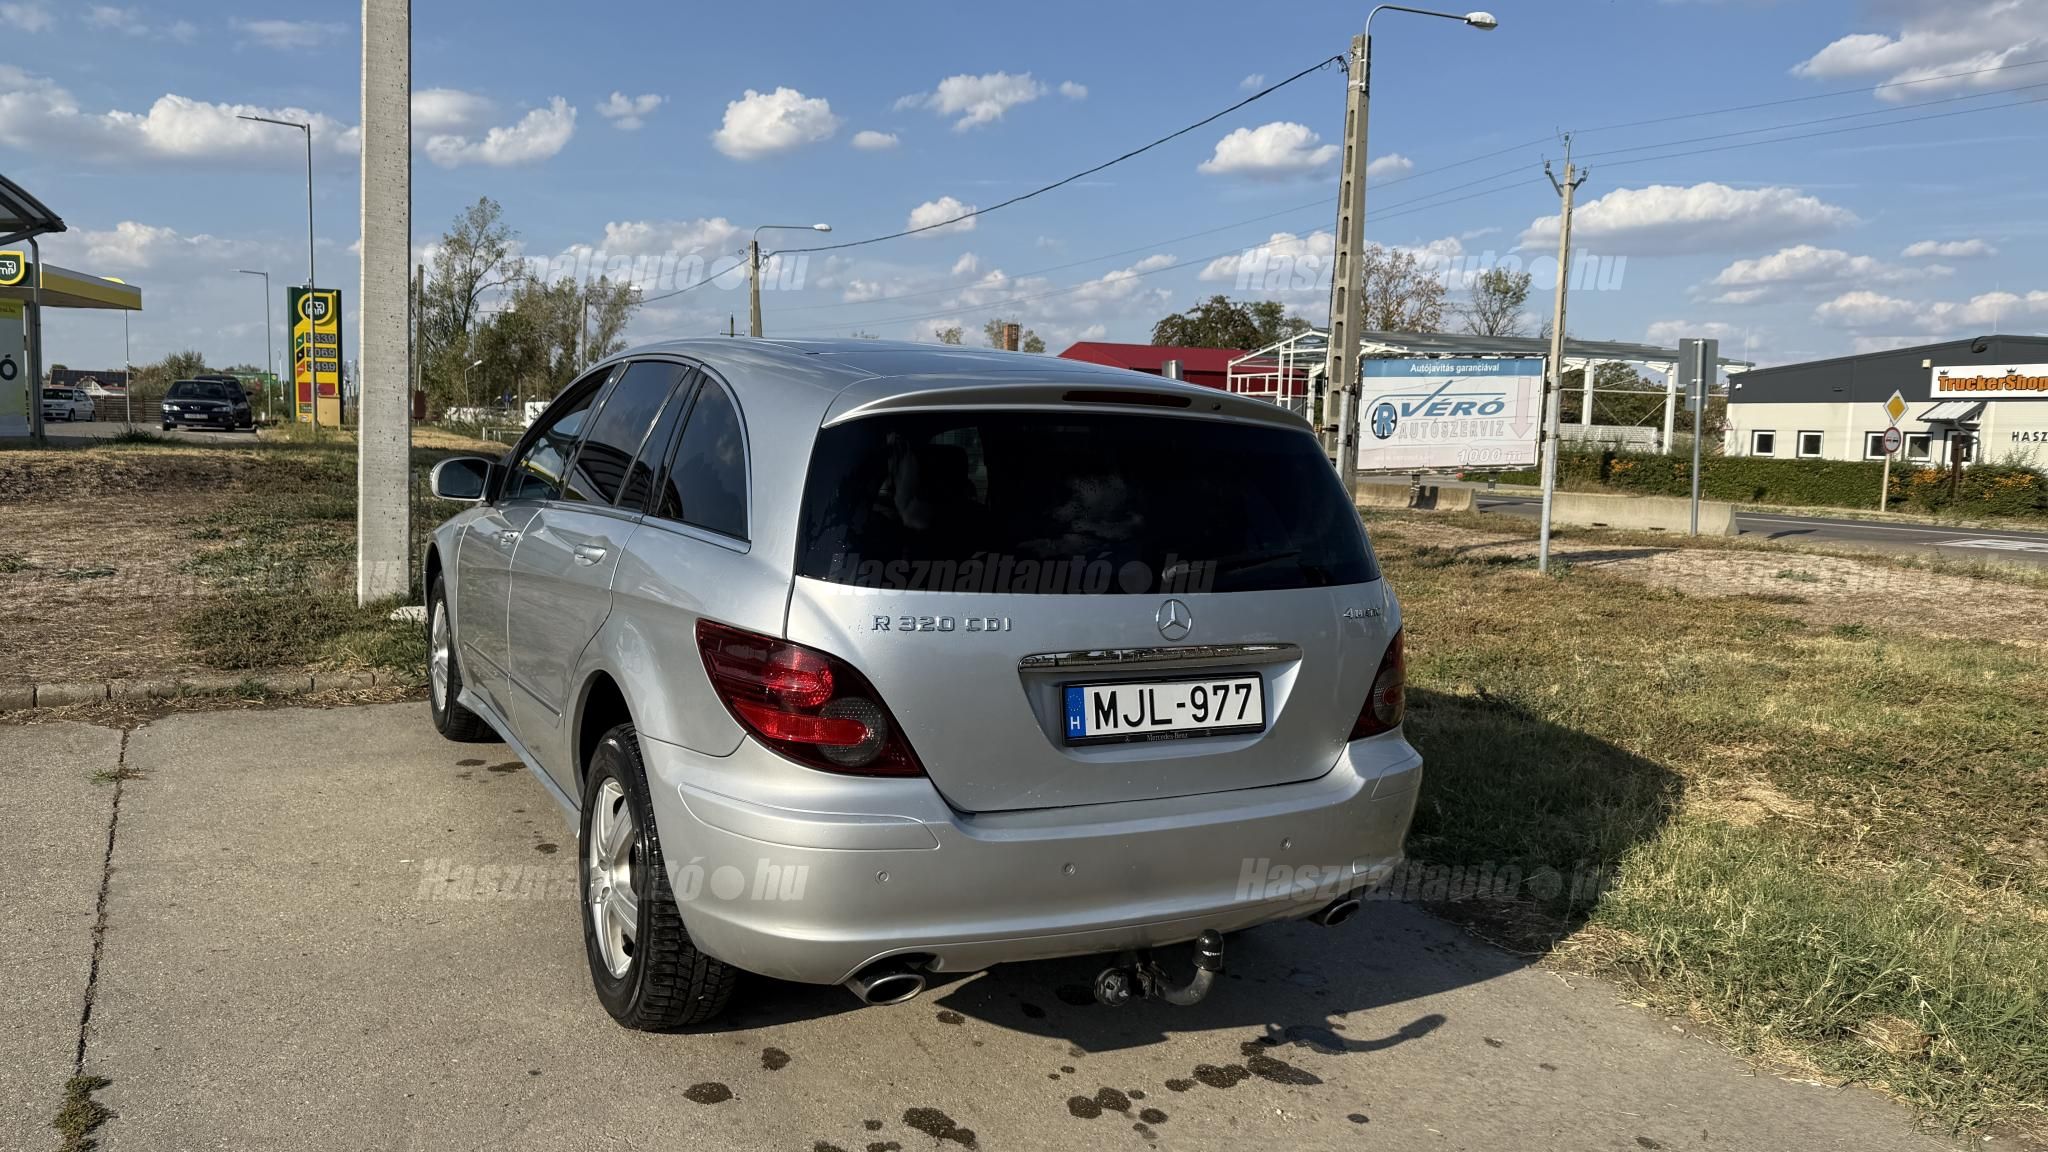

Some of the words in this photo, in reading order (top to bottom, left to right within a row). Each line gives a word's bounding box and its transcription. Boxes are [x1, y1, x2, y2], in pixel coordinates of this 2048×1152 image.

[1401, 383, 1505, 417] VÉRÓ
[1398, 418, 1504, 439] AUTÓSZERVIZ
[1456, 448, 1502, 464] 1000
[871, 615, 890, 631] R
[899, 616, 955, 631] 320
[965, 617, 1011, 631] CDI
[1093, 683, 1252, 729] MJL-977
[1070, 716, 1080, 730] H
